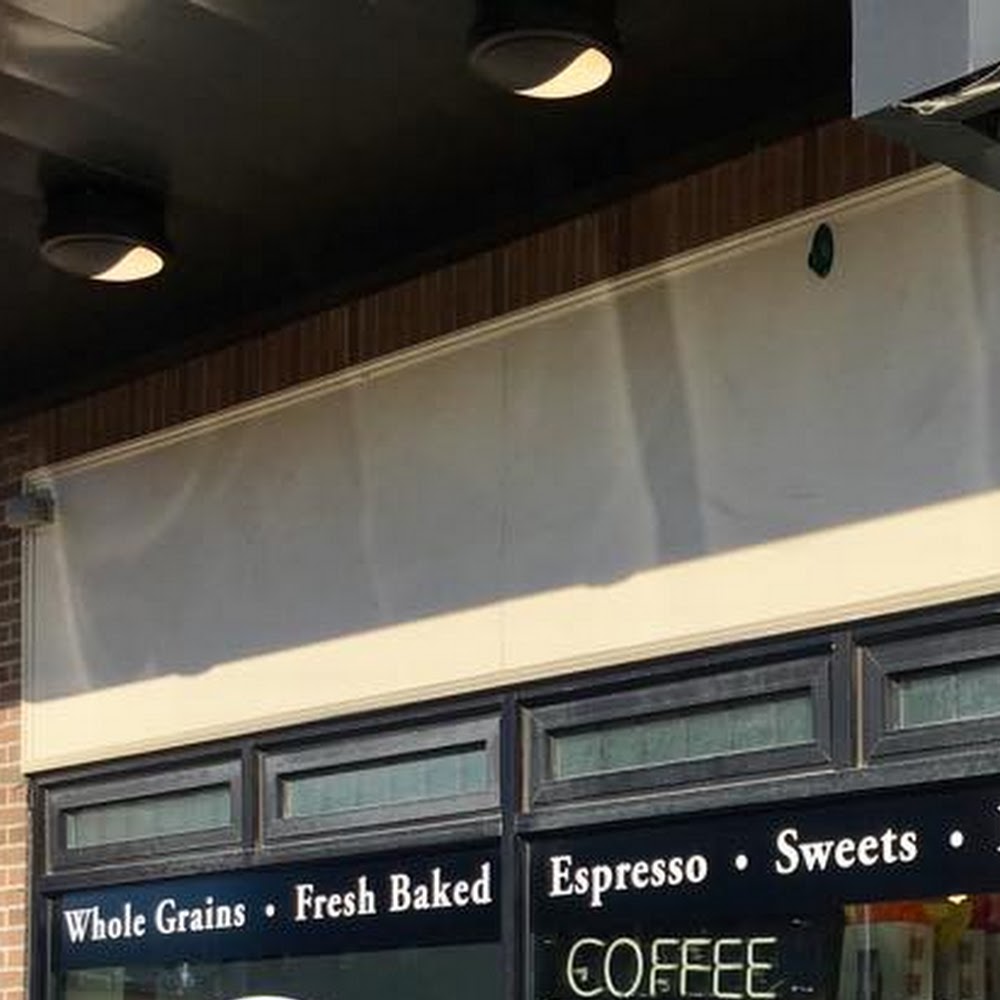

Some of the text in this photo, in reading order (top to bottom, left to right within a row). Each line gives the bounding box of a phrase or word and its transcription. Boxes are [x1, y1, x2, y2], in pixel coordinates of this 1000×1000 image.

[63, 862, 493, 944] Whole Grains Fresh Baked
[549, 853, 708, 907] Espresso
[775, 827, 918, 875] Sweets
[567, 936, 778, 999] COFFEE
